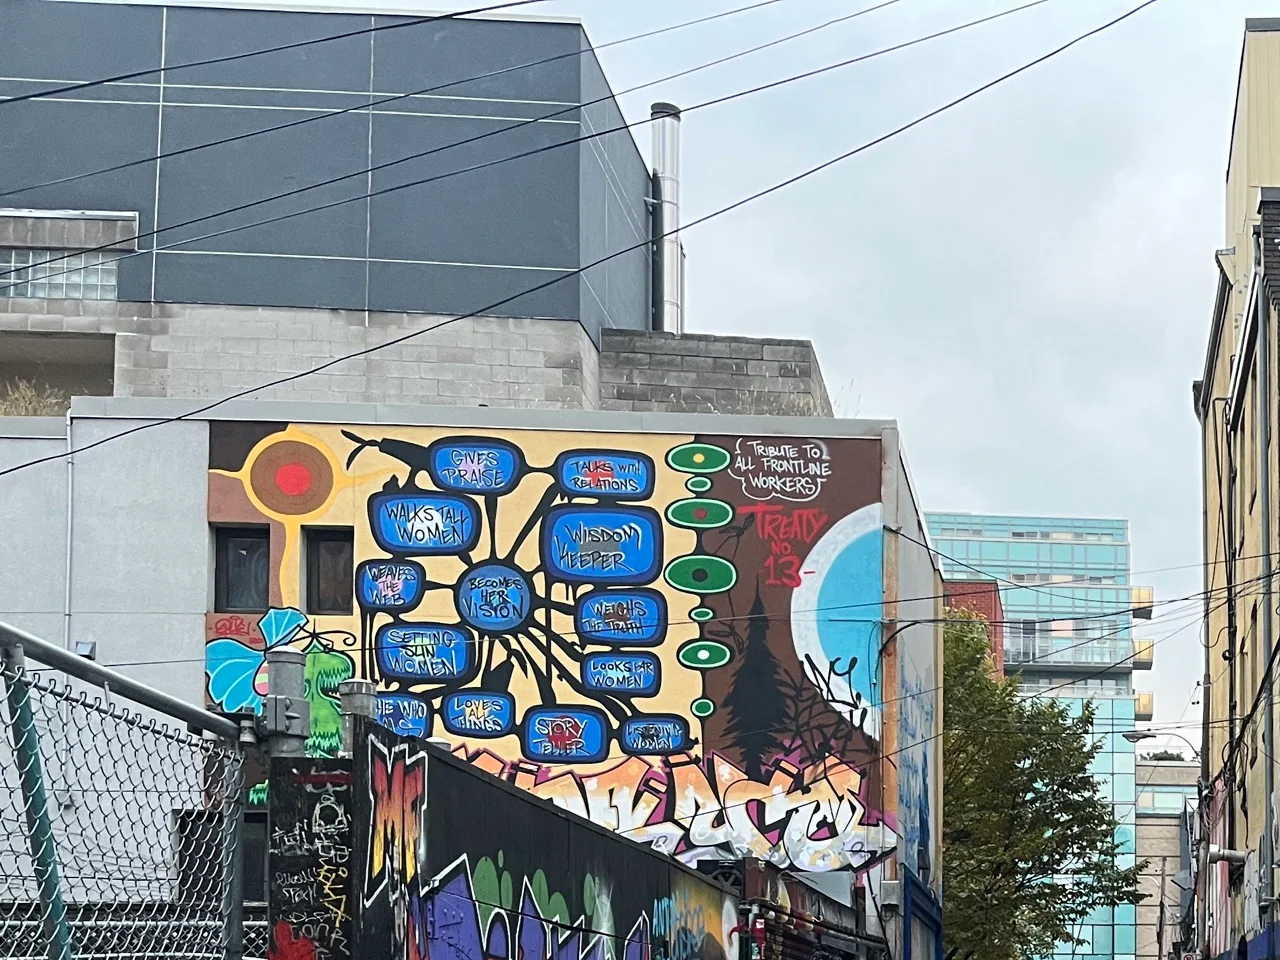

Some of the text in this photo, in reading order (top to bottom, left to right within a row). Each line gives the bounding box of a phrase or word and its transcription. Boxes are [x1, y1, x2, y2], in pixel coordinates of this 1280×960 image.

[450, 449, 499, 467] GIVES
[747, 439, 821, 459] TRIBUTE TO
[570, 459, 642, 475] TALKS WITH
[735, 456, 832, 477] ALL FRONTLINE
[441, 466, 505, 488] PRAISE
[569, 477, 640, 493] RELATIONS
[748, 473, 818, 496] WORKERS
[384, 501, 470, 527] WALKS TALL
[738, 503, 829, 544] TREATY
[396, 523, 467, 546] WOMEN
[563, 521, 643, 547] WISDOM
[553, 536, 638, 573] KEEPER
[770, 541, 793, 556] NO
[366, 564, 416, 581] WEAVES
[762, 555, 803, 589] 13
[378, 579, 402, 594] THE
[465, 575, 523, 592] BECOMES
[369, 589, 406, 606] WEB
[480, 587, 512, 605] HER
[462, 596, 524, 620] VISION
[588, 599, 648, 618] WEIGHS
[582, 618, 603, 634] THE
[386, 630, 457, 646] SETTING
[405, 642, 437, 660] SUN
[387, 655, 458, 678] WOMEN
[590, 659, 656, 675] LOOKS FAR
[591, 673, 645, 689] WOMEN
[397, 699, 428, 720] WHO
[454, 698, 505, 712] LOVES
[466, 708, 488, 720] ALL
[451, 717, 504, 732] THINGS
[534, 716, 590, 739] STORY
[531, 737, 589, 757] TELLER
[628, 736, 675, 751] WOMEN
